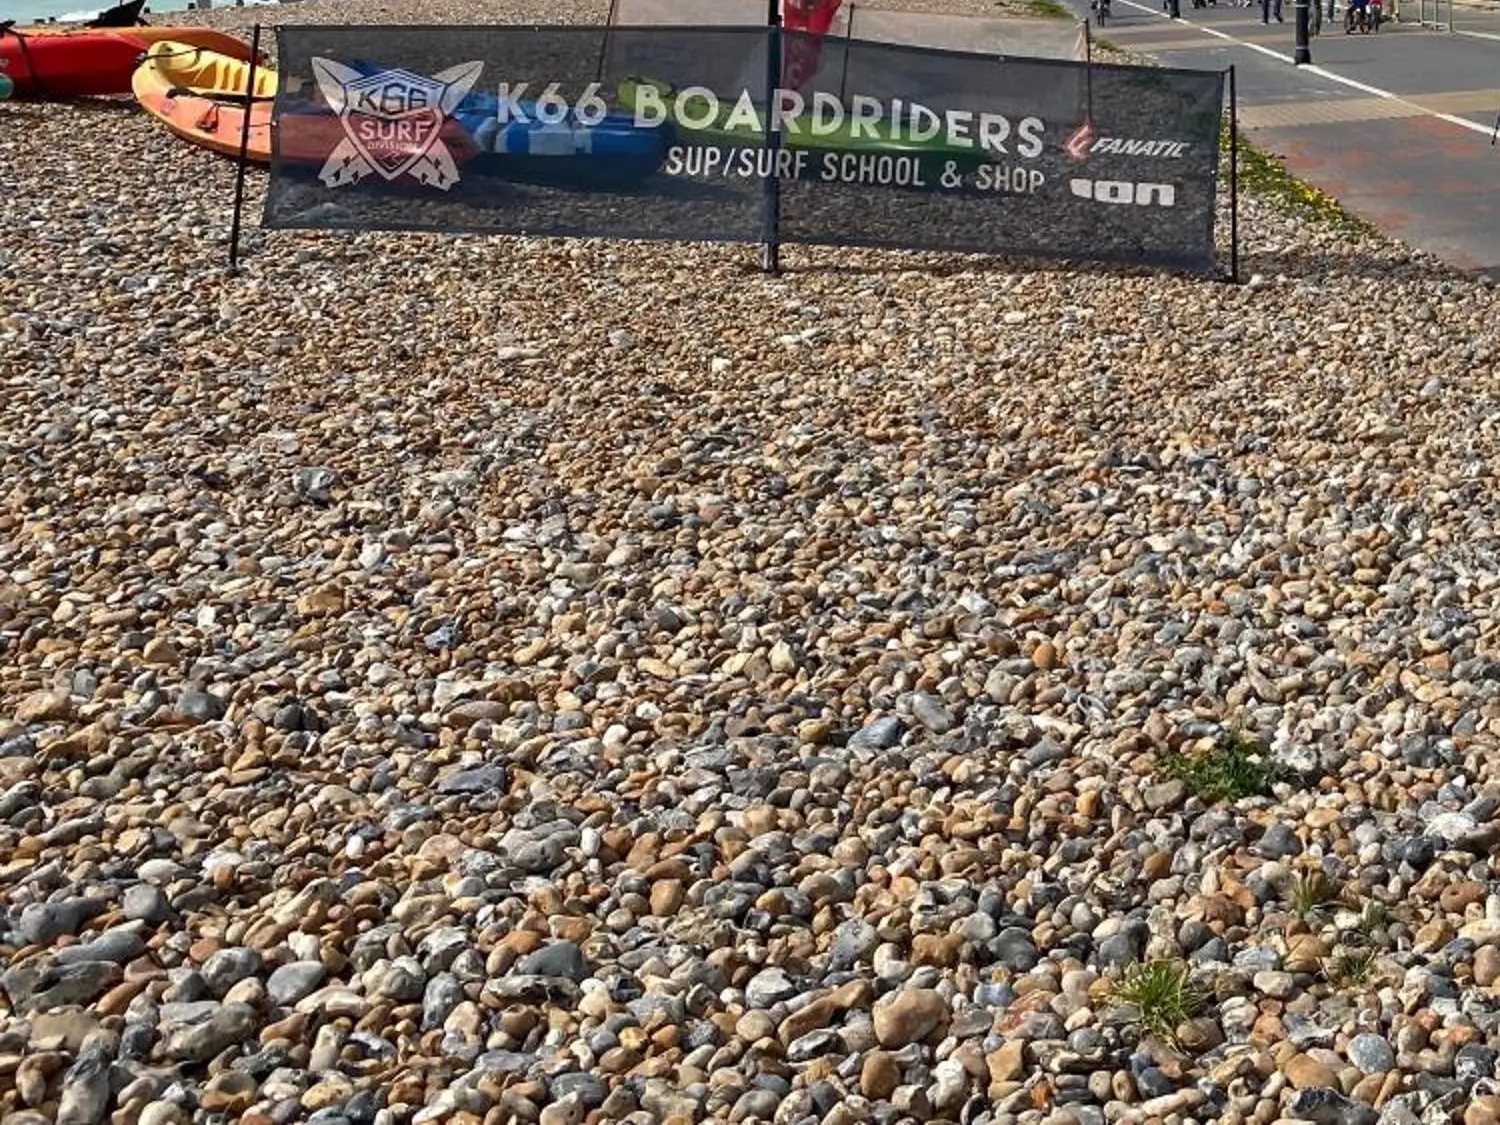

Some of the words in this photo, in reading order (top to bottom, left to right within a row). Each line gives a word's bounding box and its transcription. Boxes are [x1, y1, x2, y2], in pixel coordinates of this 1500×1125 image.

[360, 120, 432, 141] SURF
[497, 82, 607, 125] K66
[634, 85, 1045, 159] BOARDRIDERS
[1090, 137, 1190, 159] FANATIC
[666, 146, 808, 178] SUP/SURF
[822, 152, 925, 187] SCHOOL
[940, 160, 964, 188] &
[976, 163, 1045, 194] SHOP
